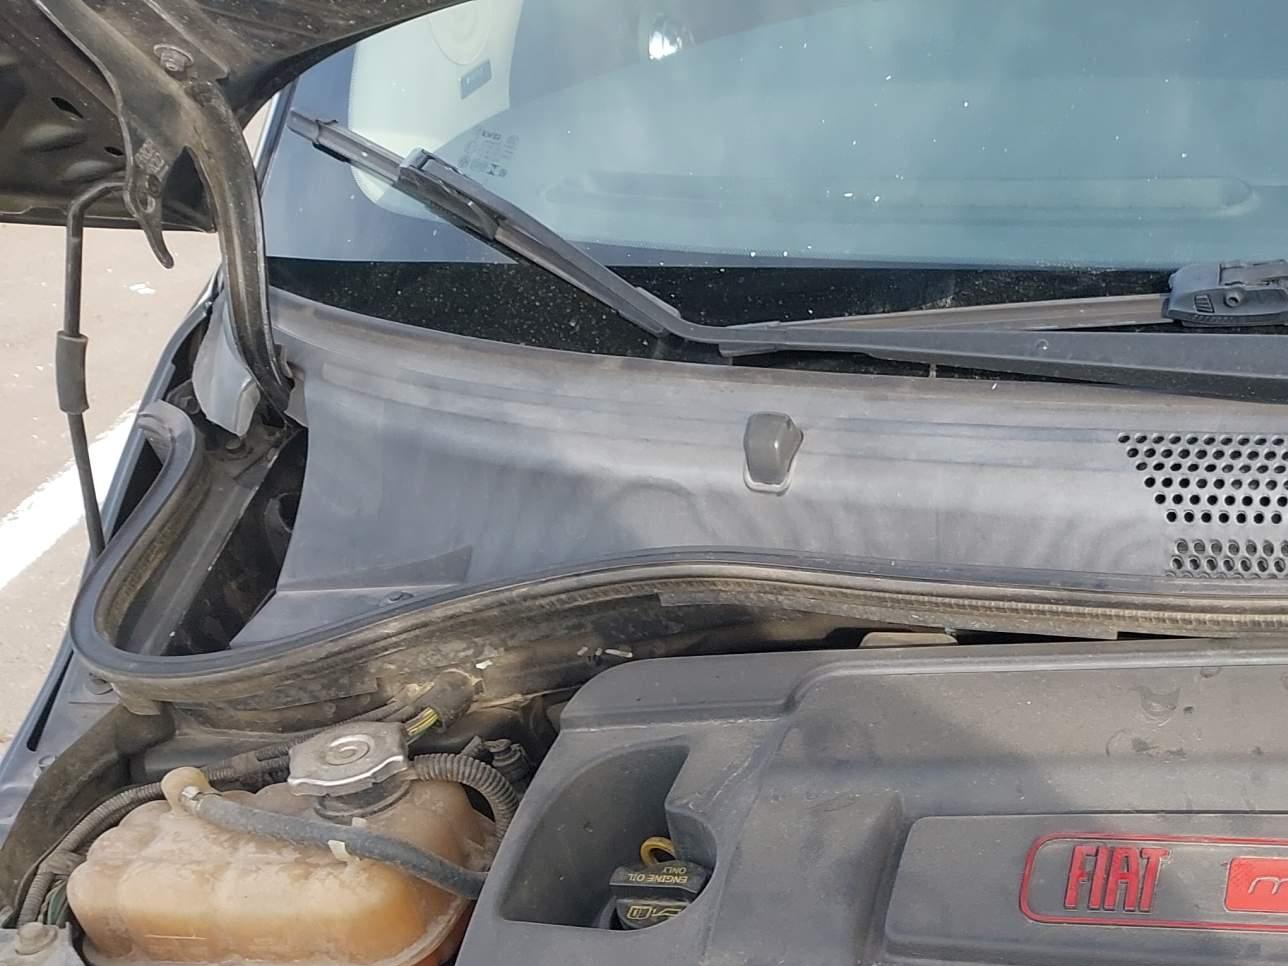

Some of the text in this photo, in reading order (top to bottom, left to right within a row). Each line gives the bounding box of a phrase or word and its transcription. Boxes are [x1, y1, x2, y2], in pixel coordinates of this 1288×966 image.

[662, 866, 687, 874] ONLY
[627, 873, 688, 884] ENGINE OIL
[1063, 844, 1172, 913] FIAT
